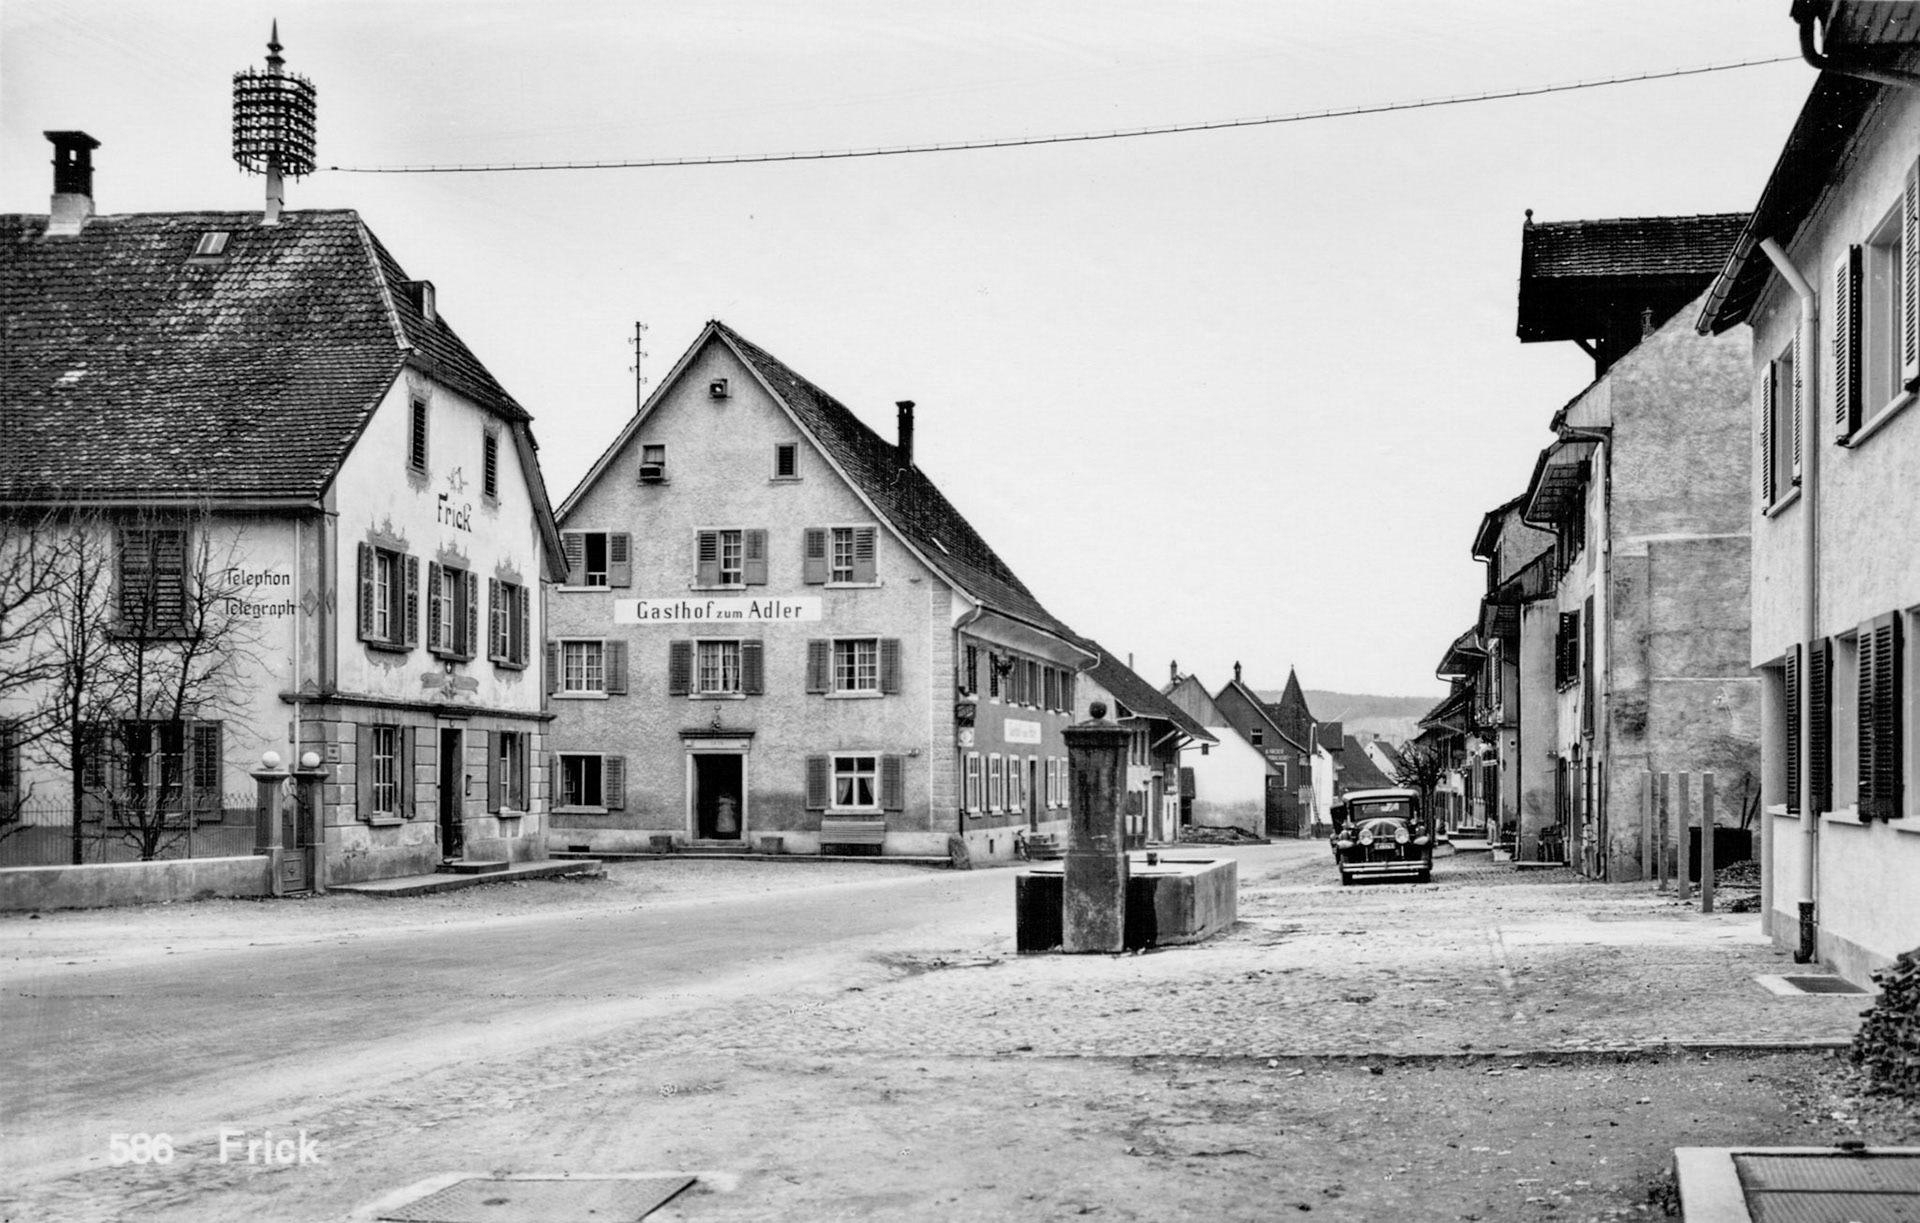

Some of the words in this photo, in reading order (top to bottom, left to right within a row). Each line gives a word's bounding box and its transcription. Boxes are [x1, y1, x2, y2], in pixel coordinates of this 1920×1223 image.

[437, 494, 473, 532] Frick
[226, 568, 291, 587] Telephon
[224, 598, 296, 619] Telegraph
[636, 601, 715, 619] Gasthof
[716, 609, 743, 619] zum
[748, 600, 803, 619] Adler
